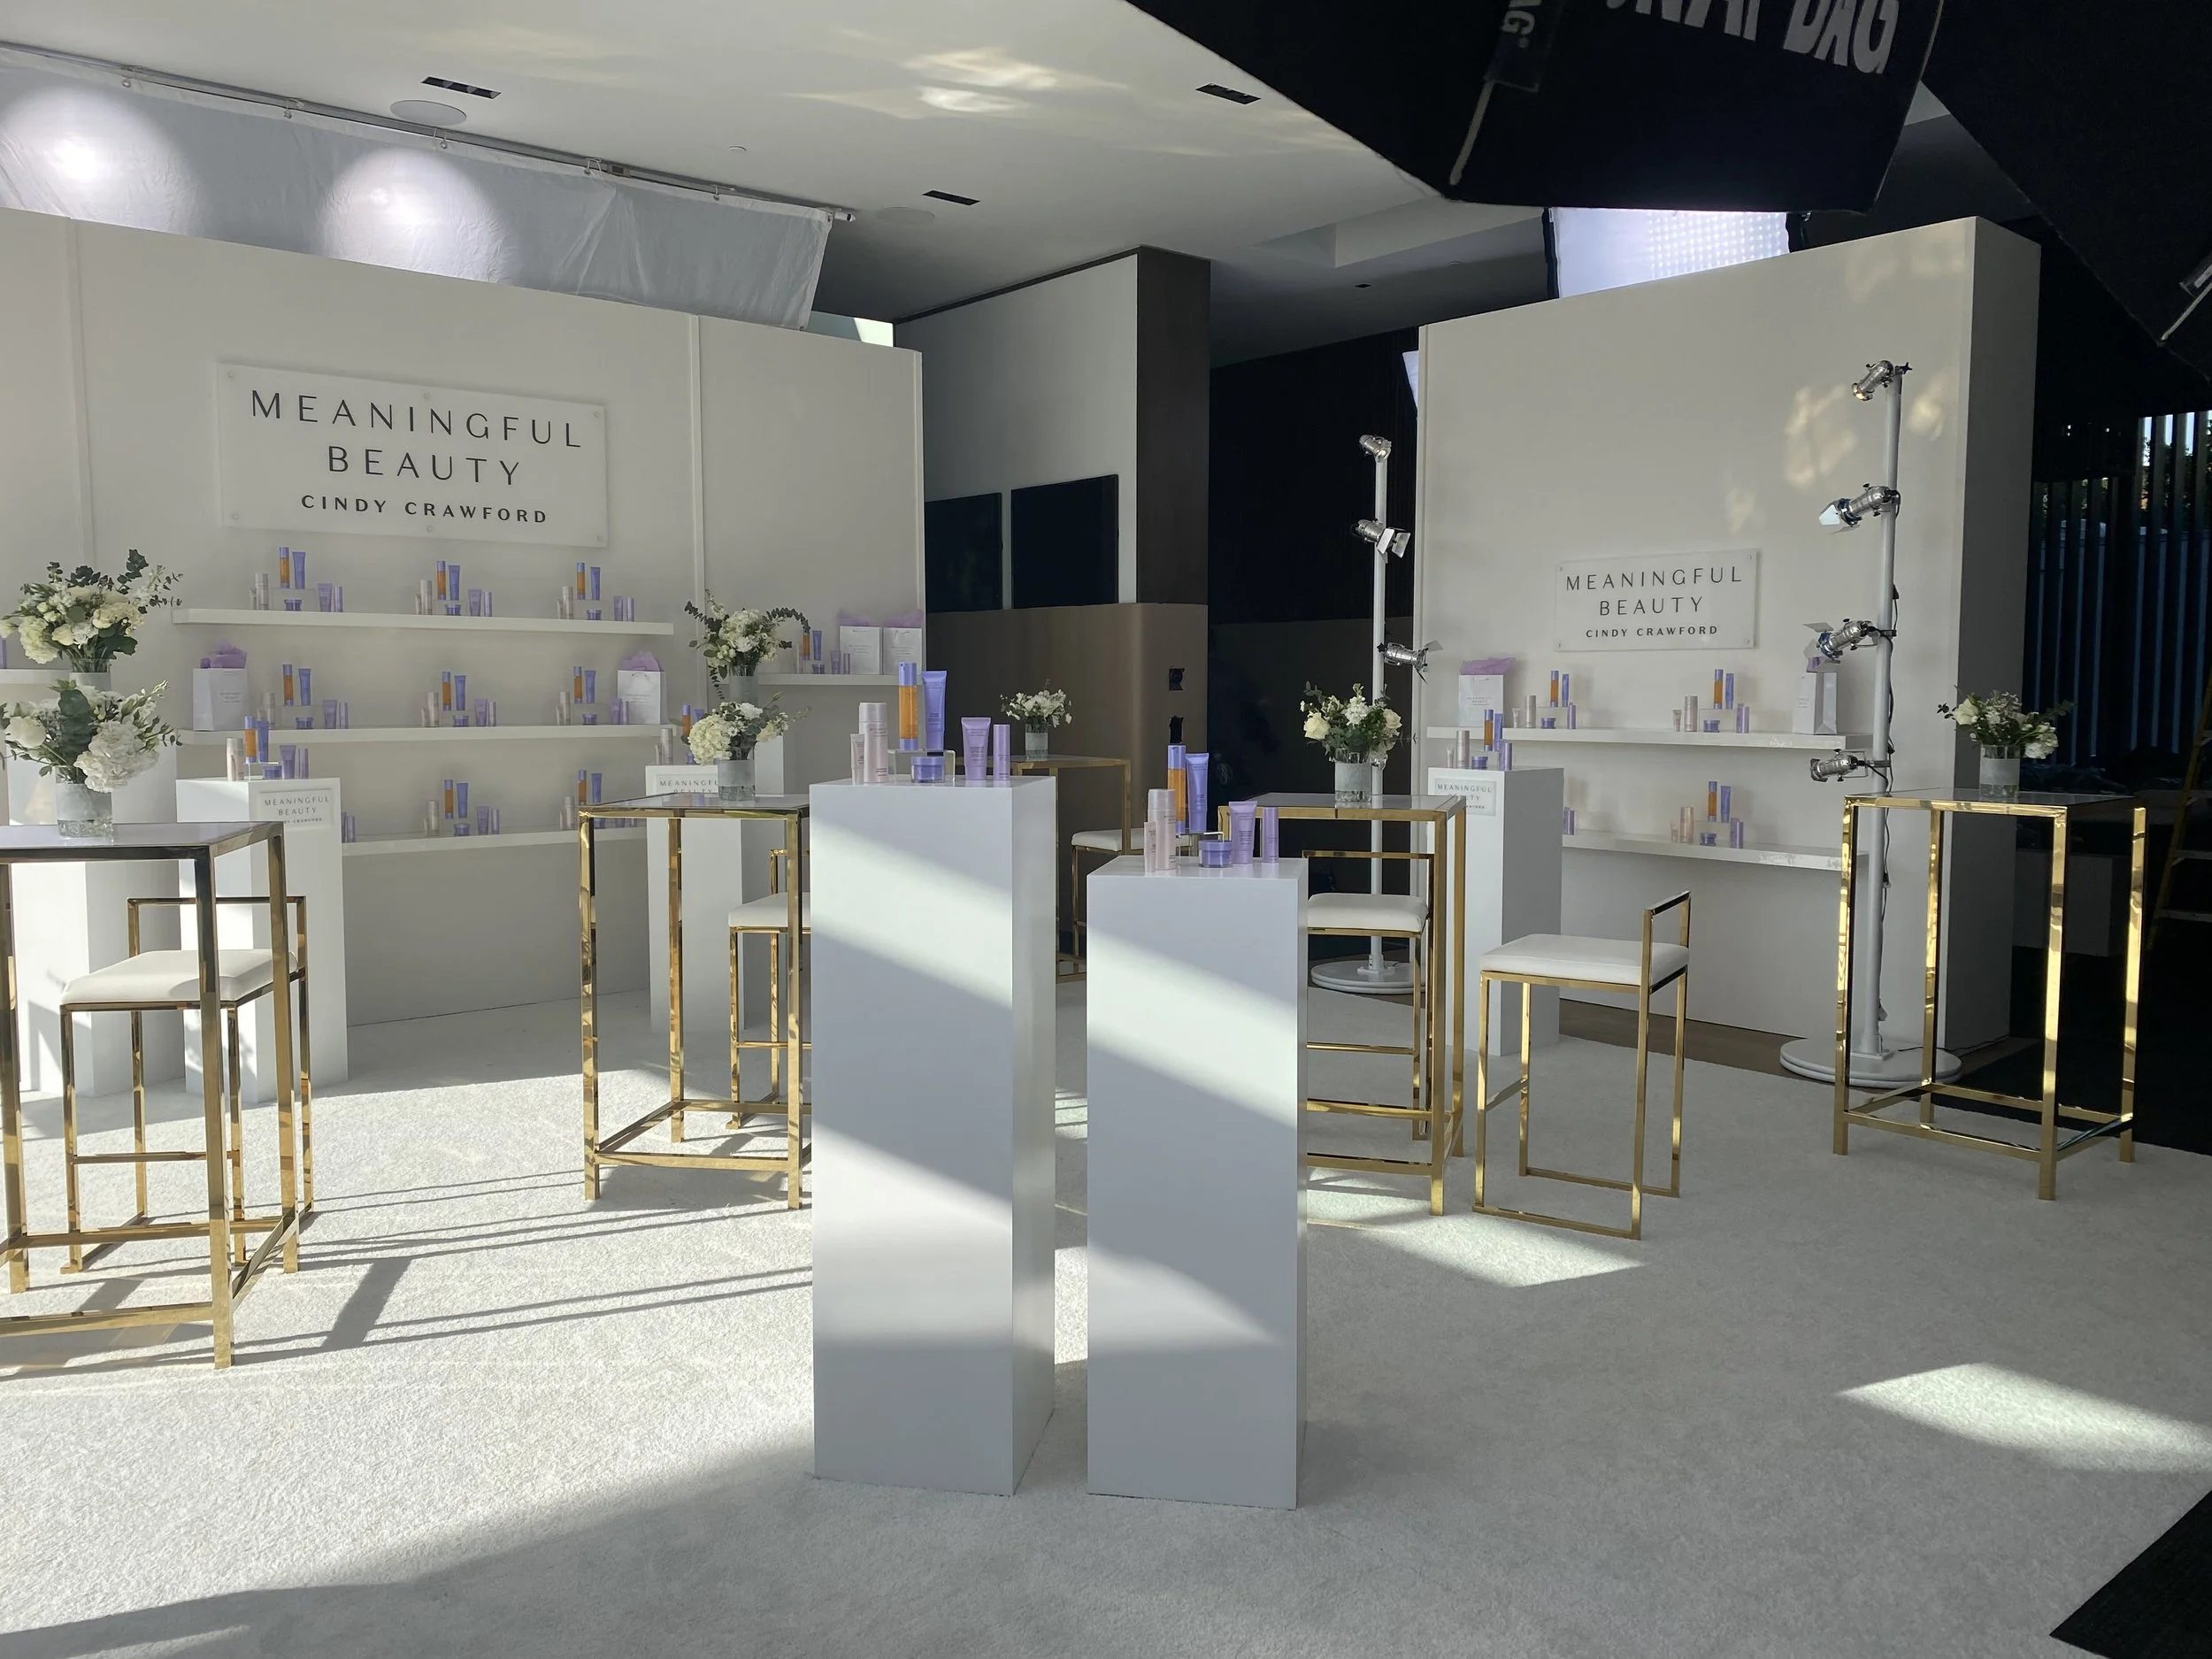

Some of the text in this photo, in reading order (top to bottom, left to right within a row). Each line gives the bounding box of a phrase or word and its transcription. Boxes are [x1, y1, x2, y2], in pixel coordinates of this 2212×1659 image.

[251, 389, 581, 448] MEANINGFUL
[328, 445, 519, 486] BEAUTY
[301, 495, 546, 524] CINDY CRAWFORD
[1566, 565, 1742, 591] MEANINGFUL
[1599, 595, 1703, 616] BEAUTY
[1586, 626, 1717, 638] CINDY CRAWFORD
[1437, 784, 1492, 793] MEANINGFUL
[264, 795, 330, 806] MEANINGFUL
[279, 807, 317, 816] BEAUTY
